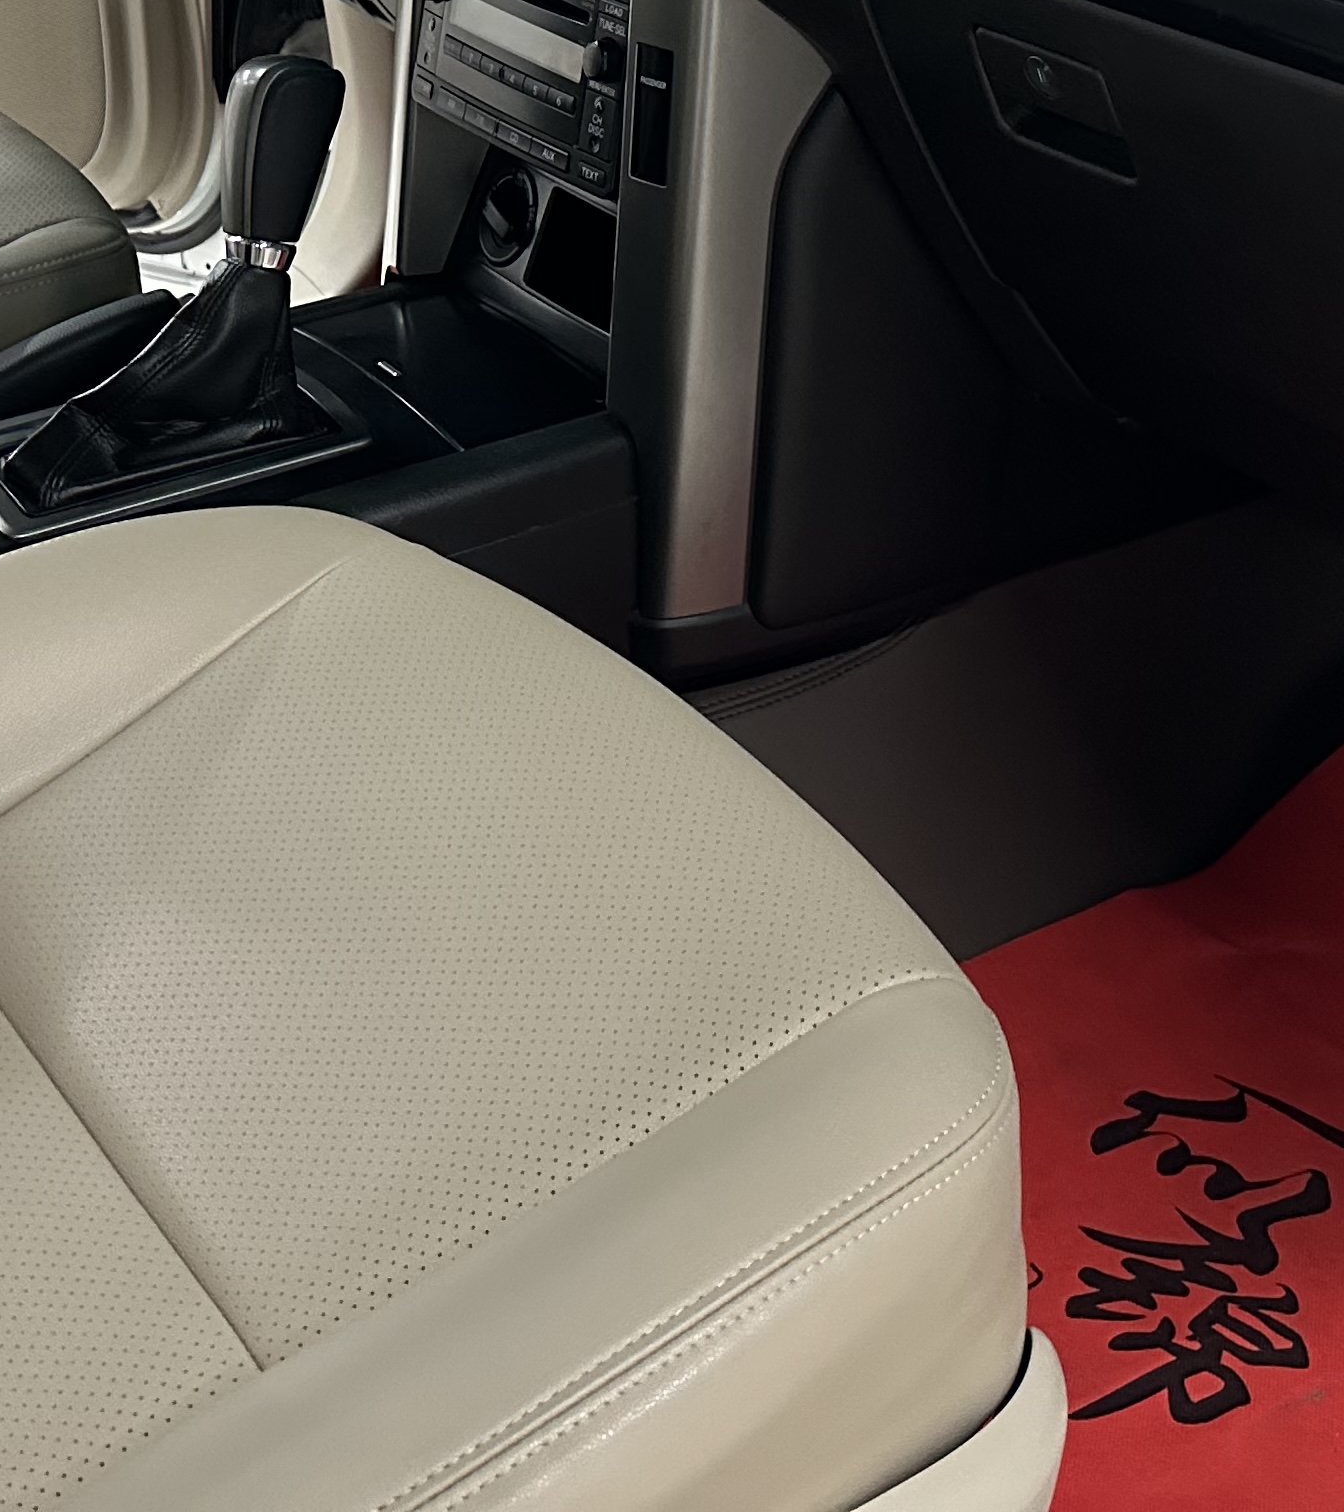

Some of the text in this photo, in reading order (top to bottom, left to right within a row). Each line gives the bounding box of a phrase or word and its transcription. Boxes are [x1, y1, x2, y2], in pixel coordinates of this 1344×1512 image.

[604, 3, 624, 18] LOAD
[592, 113, 603, 125] CH
[587, 122, 604, 138] DISC
[542, 148, 556, 162] AUX
[581, 166, 599, 181] TEXT
